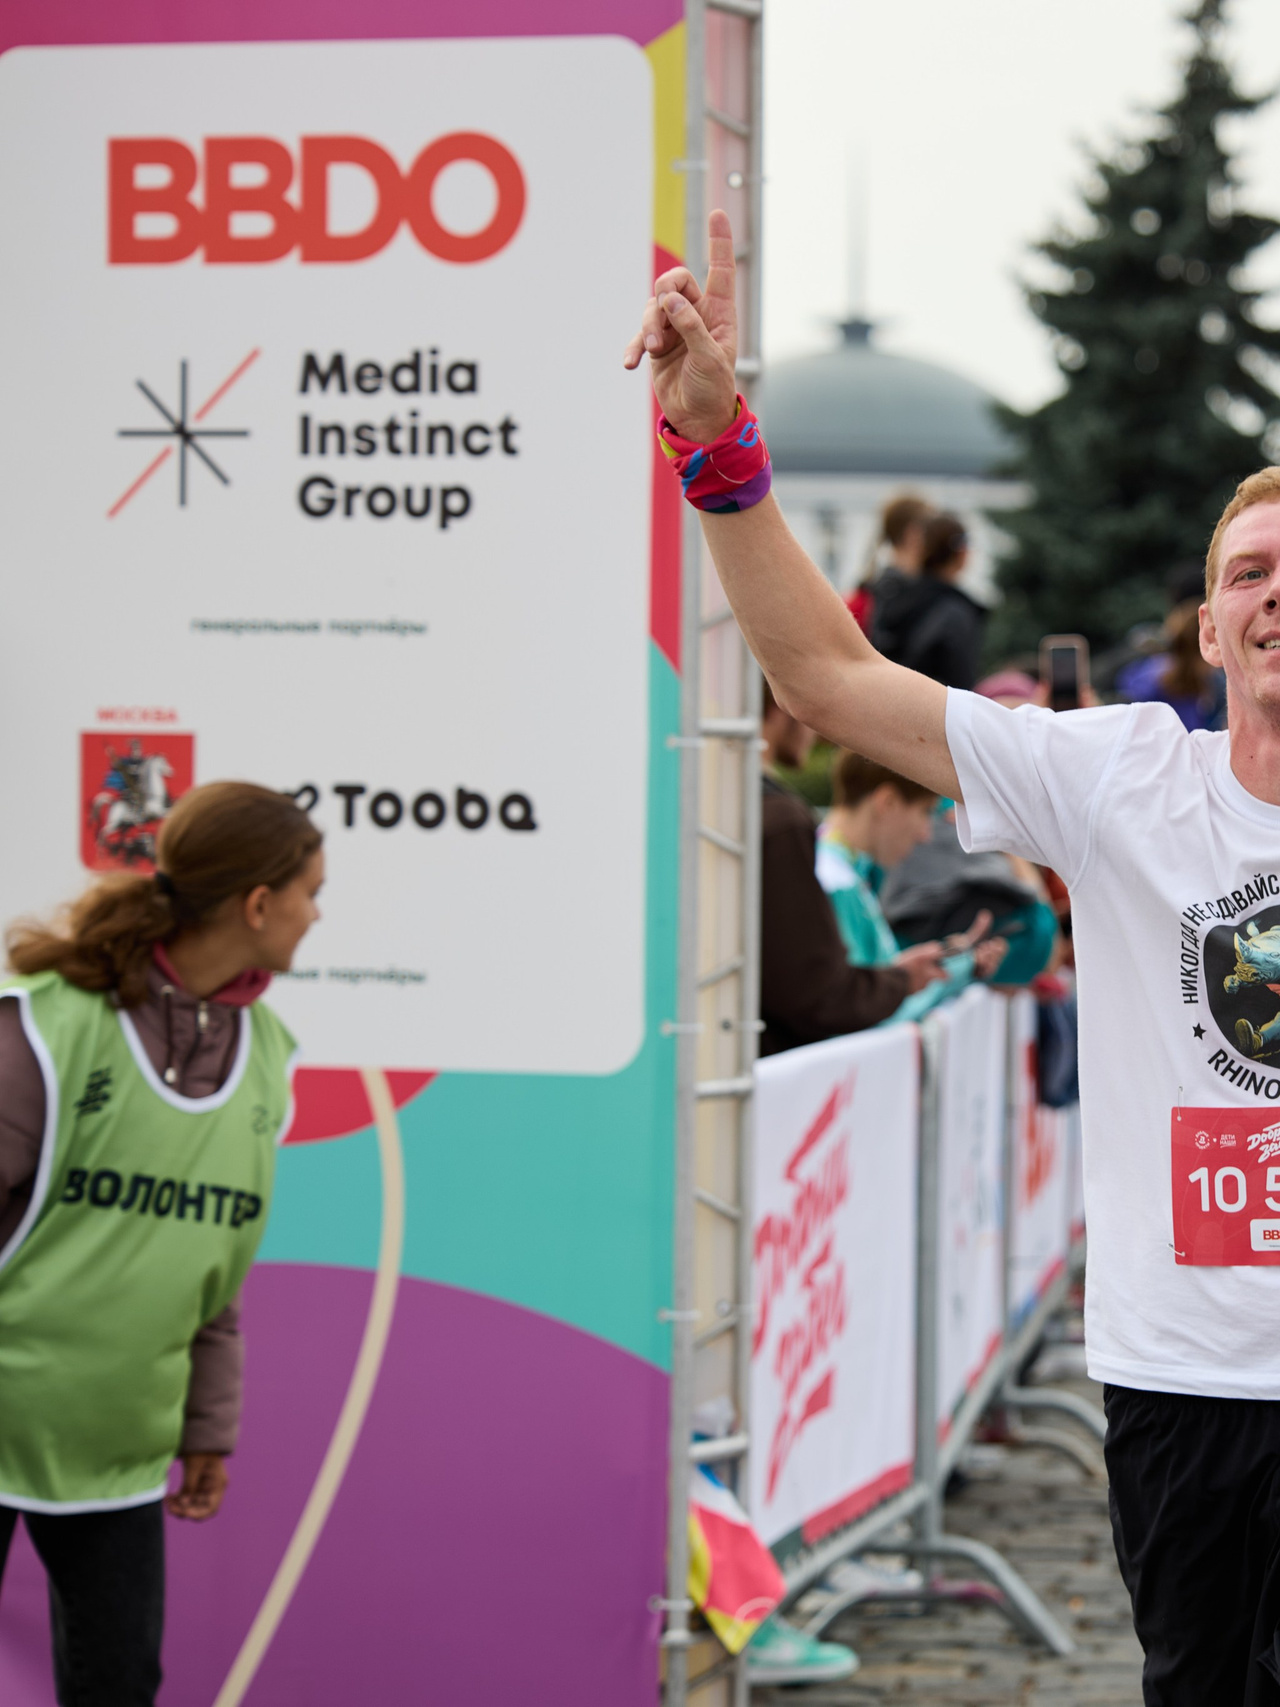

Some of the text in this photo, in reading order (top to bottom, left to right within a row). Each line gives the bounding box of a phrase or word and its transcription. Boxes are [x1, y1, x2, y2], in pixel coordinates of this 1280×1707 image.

[107, 131, 528, 266] BBDO
[299, 349, 479, 396] Media
[299, 413, 519, 457] Instinct
[298, 476, 472, 530] Group
[333, 785, 537, 831] Tooba
[1180, 921, 1200, 1004] НИКОГДА
[1188, 1166, 1247, 1213] 10
